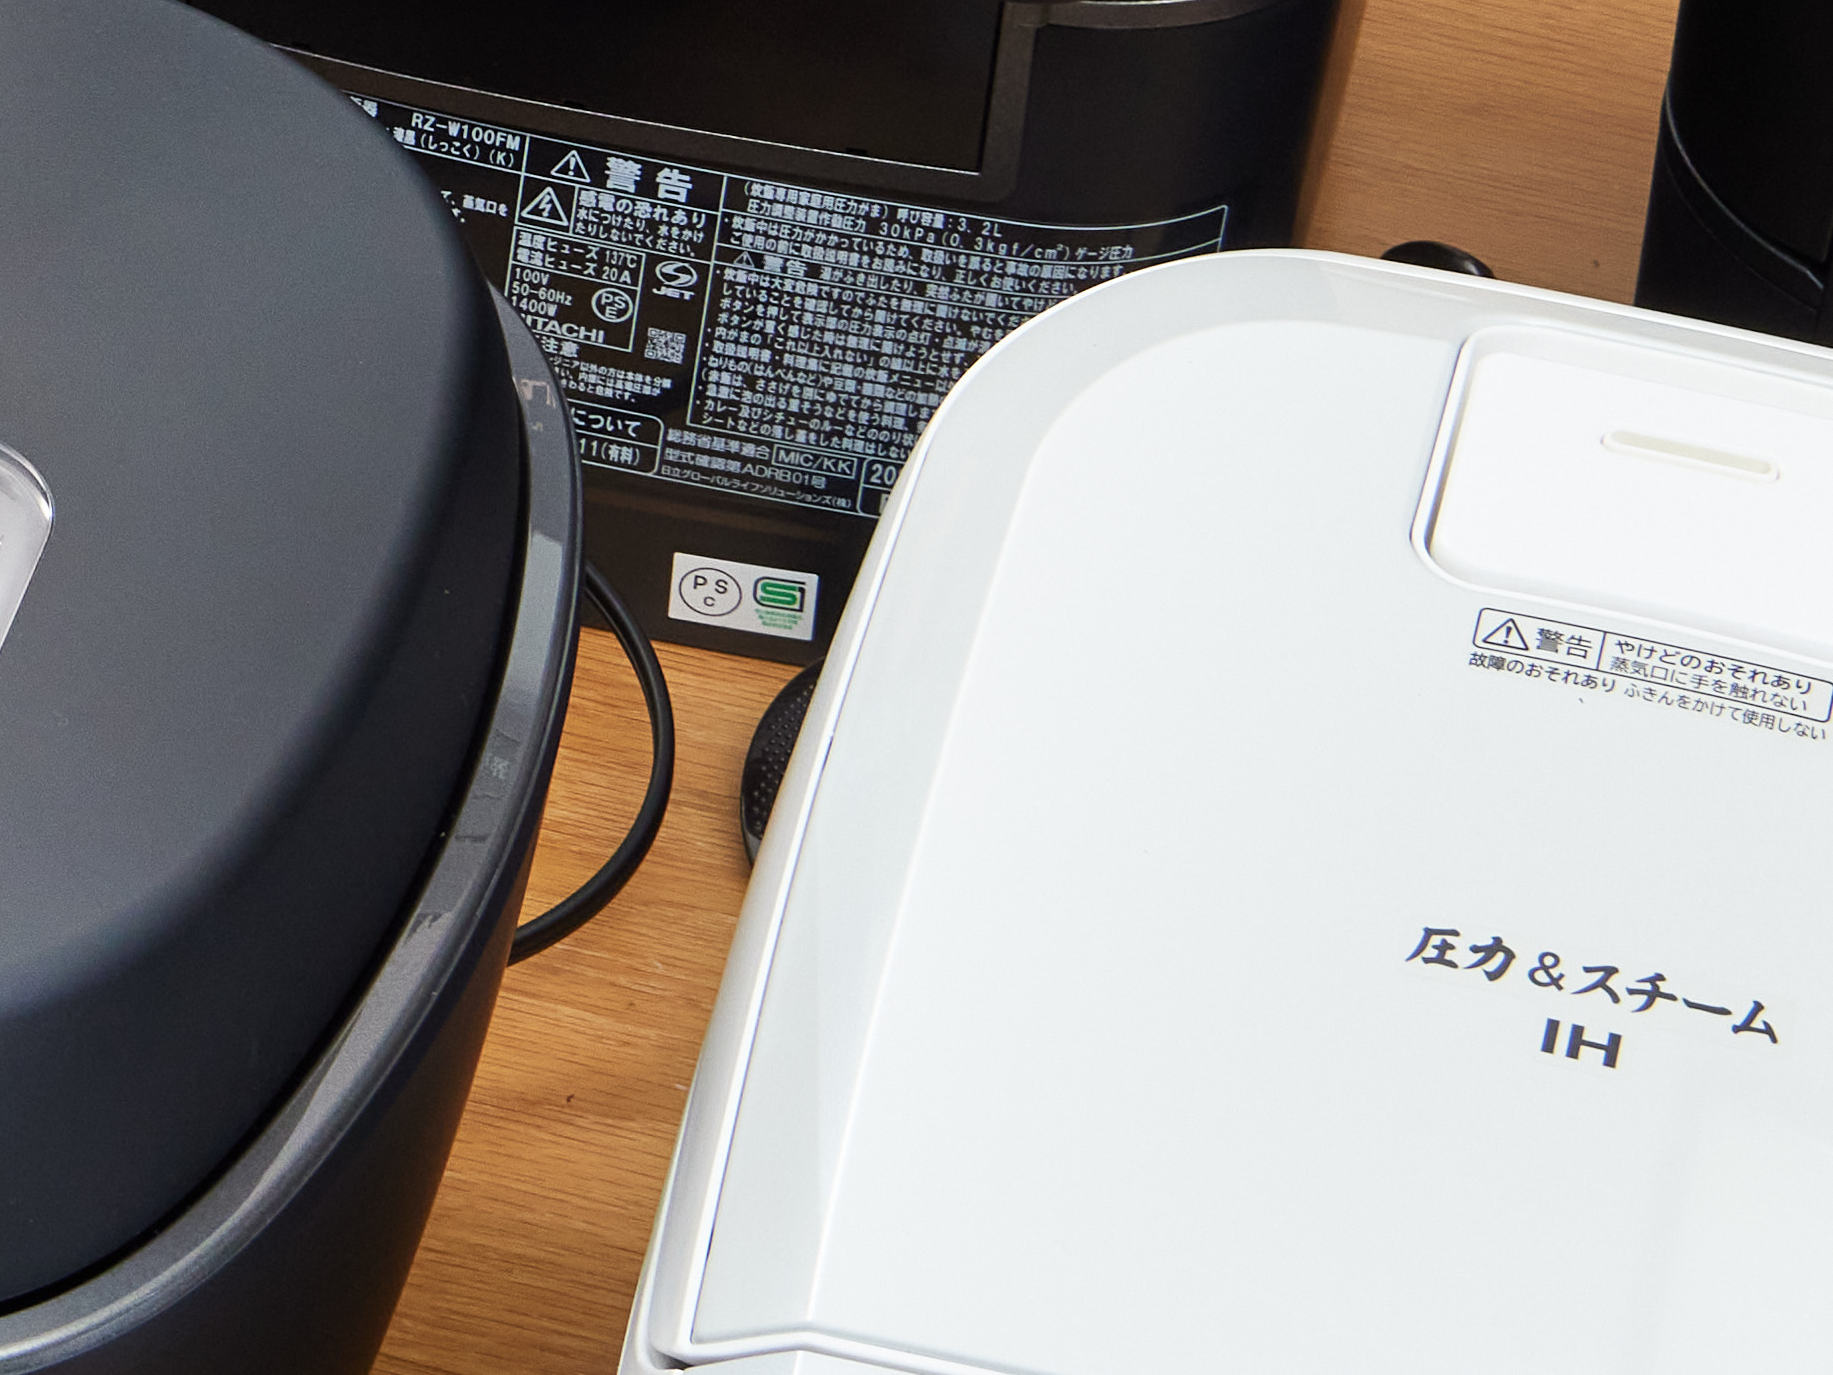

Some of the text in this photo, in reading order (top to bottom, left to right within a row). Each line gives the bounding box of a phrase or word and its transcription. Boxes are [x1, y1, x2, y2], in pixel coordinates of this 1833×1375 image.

[412, 112, 522, 151] RZ-W100FM
[604, 155, 693, 204] 警告
[578, 190, 707, 229] 感電の恐れあり
[518, 231, 598, 261] 温度ヒューズ
[514, 267, 550, 285] 100V
[511, 295, 558, 317] 1400W
[778, 449, 852, 475] MIC/KK
[1535, 627, 1814, 696] 警告 やけどのおそれあり
[1468, 652, 1827, 742] 故障のおそれあり ふきんをかけて使用しない
[1609, 655, 1809, 713] 蒸気口に手を触れない
[1541, 1017, 1622, 1070] IH
